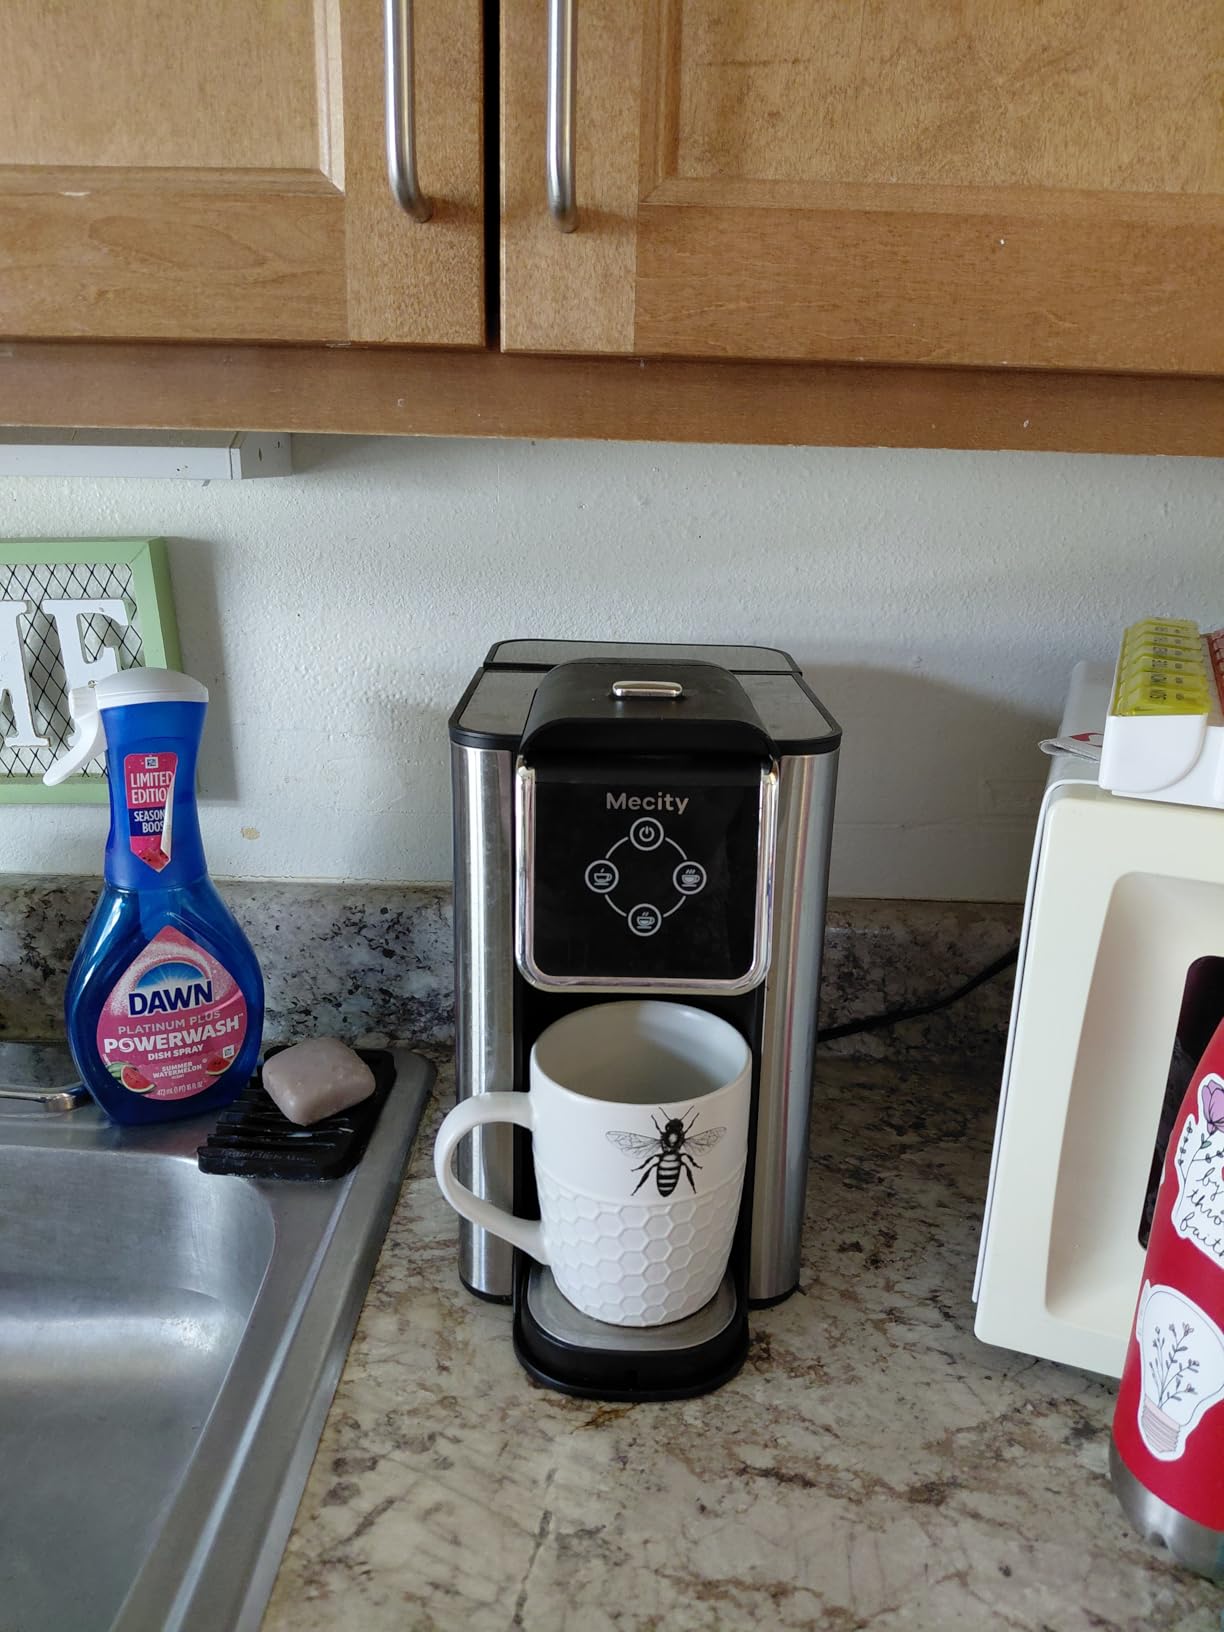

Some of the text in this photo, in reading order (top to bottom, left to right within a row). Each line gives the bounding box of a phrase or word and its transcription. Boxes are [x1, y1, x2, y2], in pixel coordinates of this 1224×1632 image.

[131, 787, 170, 804] EDITIO
[606, 792, 689, 815] Mecity
[128, 981, 213, 1016] DAWN
[118, 1010, 221, 1035] PLATINUM PLUS
[147, 1044, 204, 1061] DISH SPRAY
[152, 1063, 203, 1079] WATERMELON
[161, 1061, 193, 1072] SUMMER
[1196, 1167, 1224, 1202] by
[1186, 1188, 1224, 1226] thro
[1180, 1212, 1224, 1257] fait
